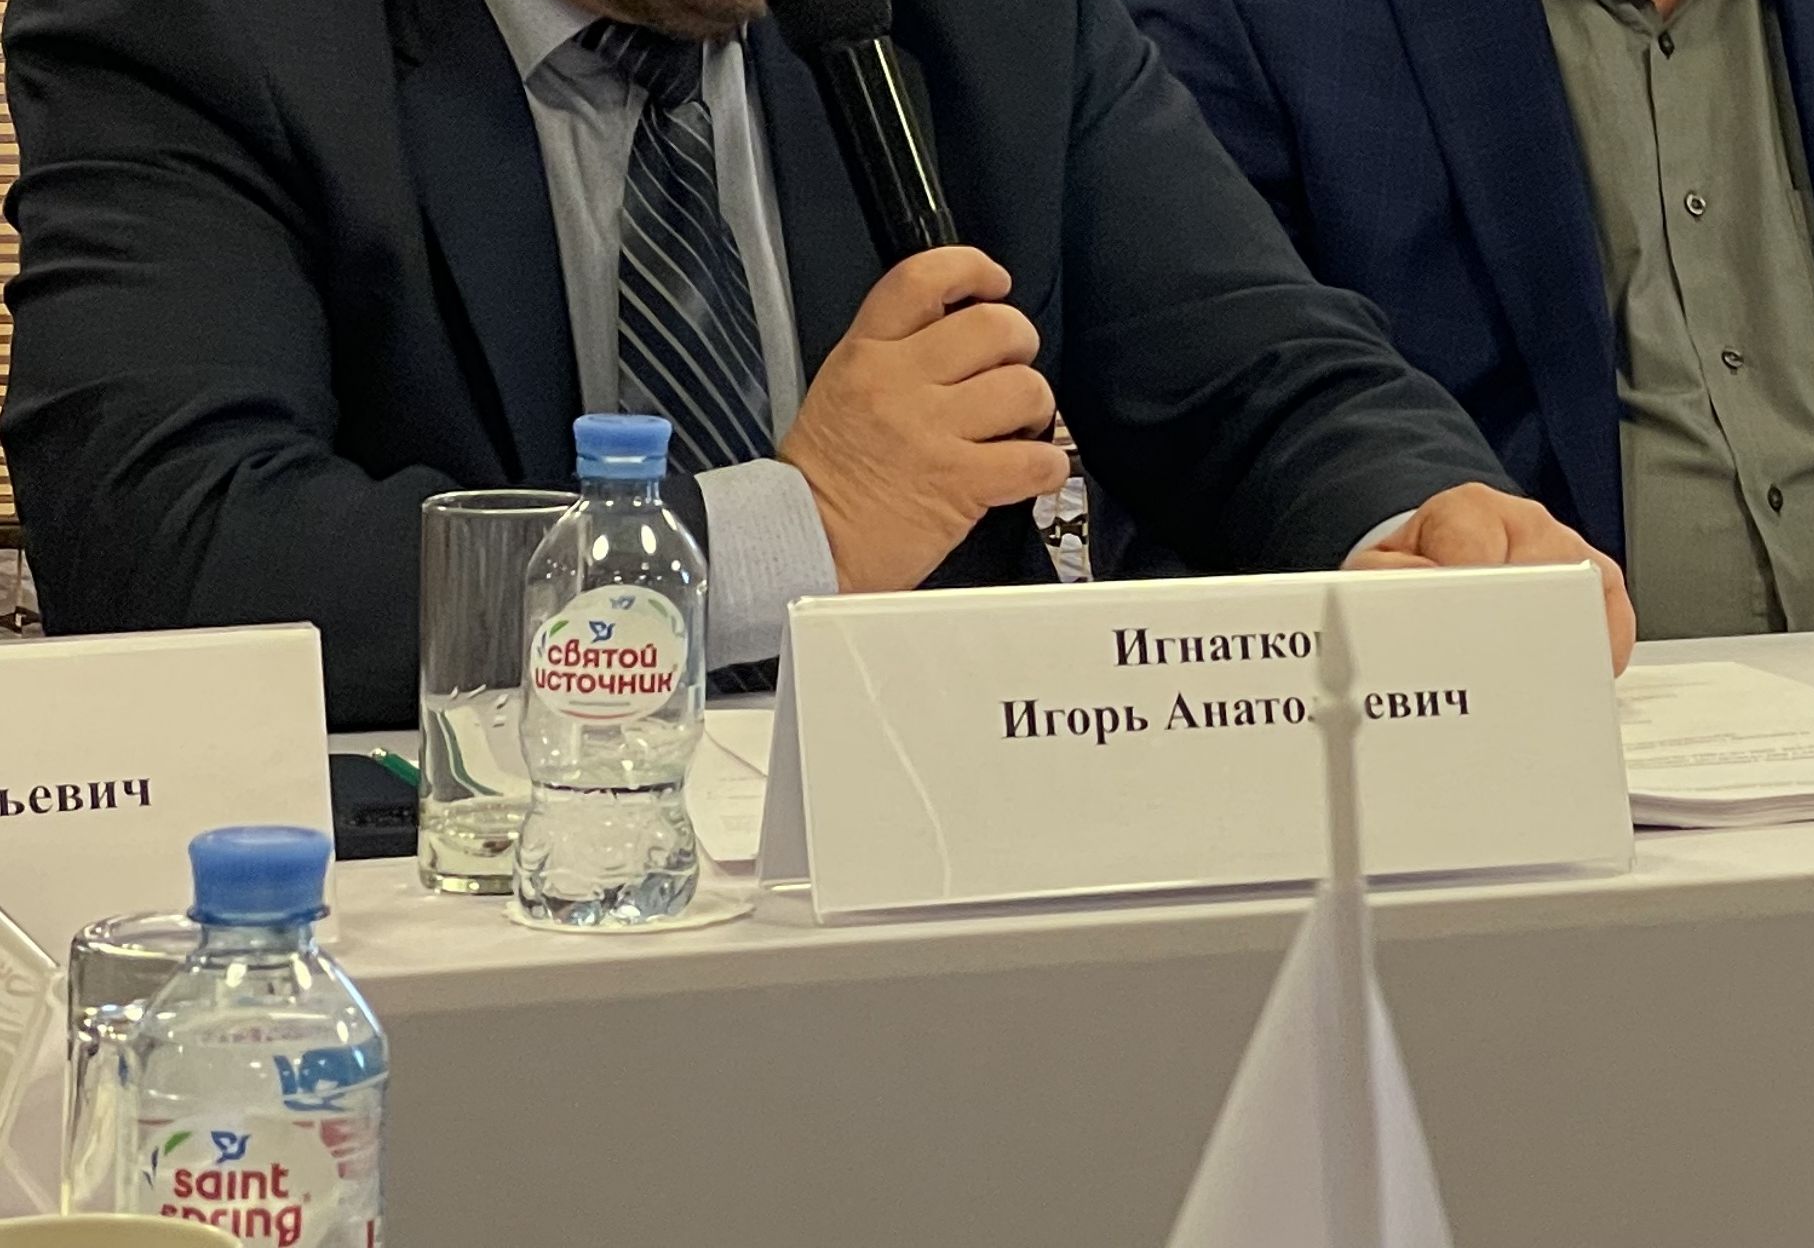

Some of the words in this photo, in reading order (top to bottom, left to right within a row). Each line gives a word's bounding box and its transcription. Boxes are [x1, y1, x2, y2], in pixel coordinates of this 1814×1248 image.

[1112, 627, 1323, 667] Игнатко
[1002, 698, 1149, 746] Игорь
[1165, 688, 1470, 731] Анатоевич
[174, 1162, 289, 1201] saint
